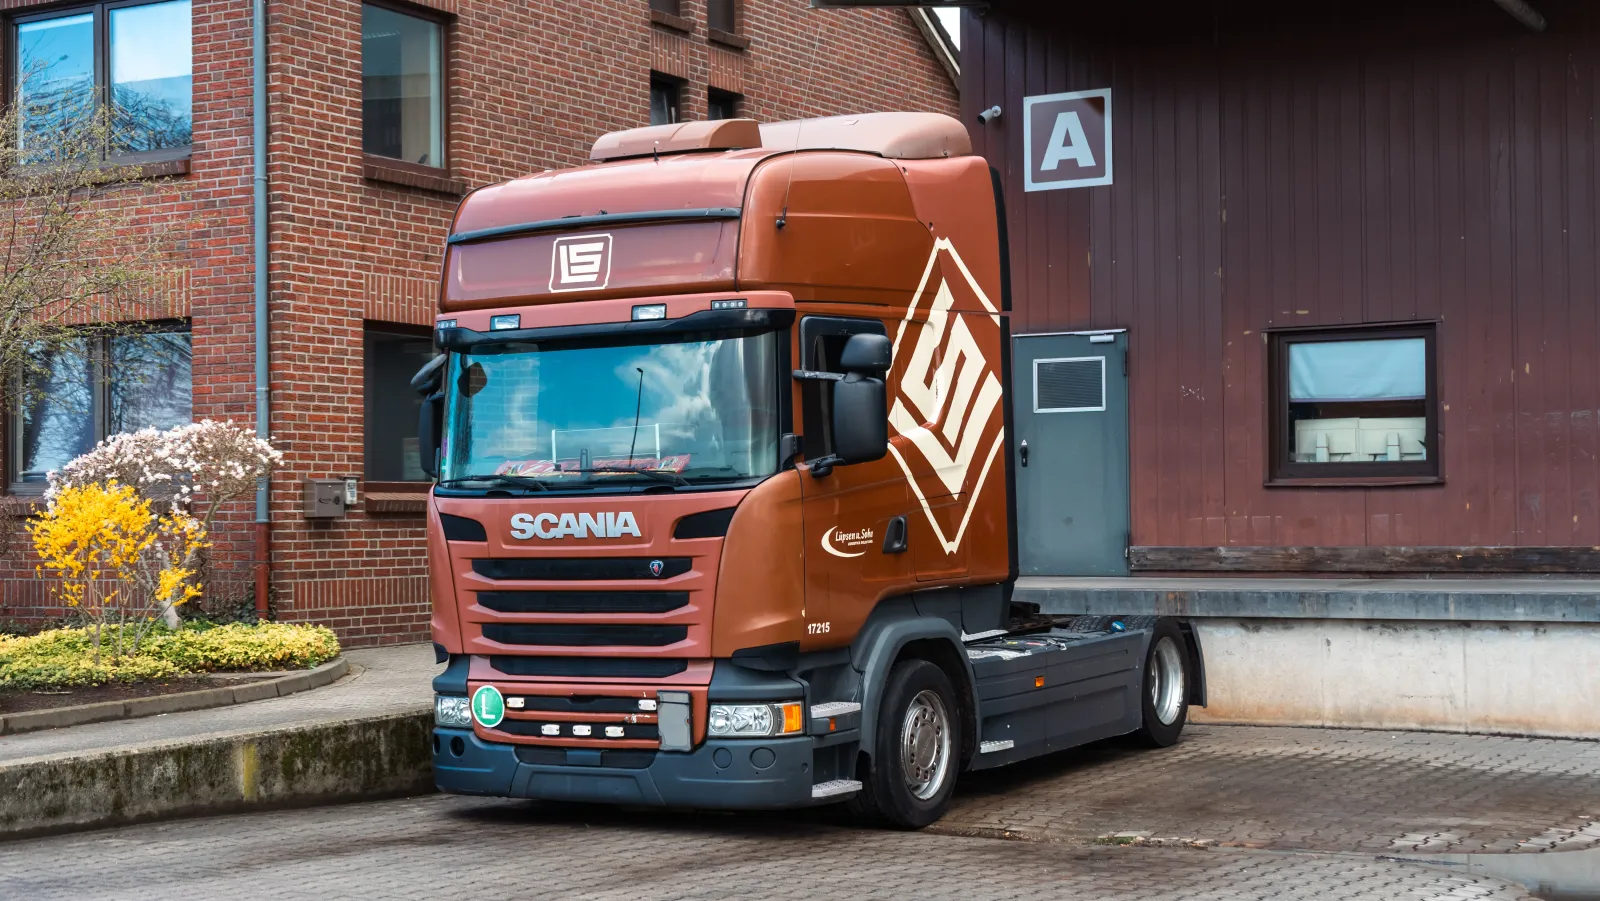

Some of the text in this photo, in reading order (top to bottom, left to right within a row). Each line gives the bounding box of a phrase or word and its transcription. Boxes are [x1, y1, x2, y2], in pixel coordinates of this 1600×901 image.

[1040, 110, 1097, 171] A
[510, 511, 642, 540] SCANIA
[807, 621, 830, 635] 17215
[481, 693, 496, 720] L
